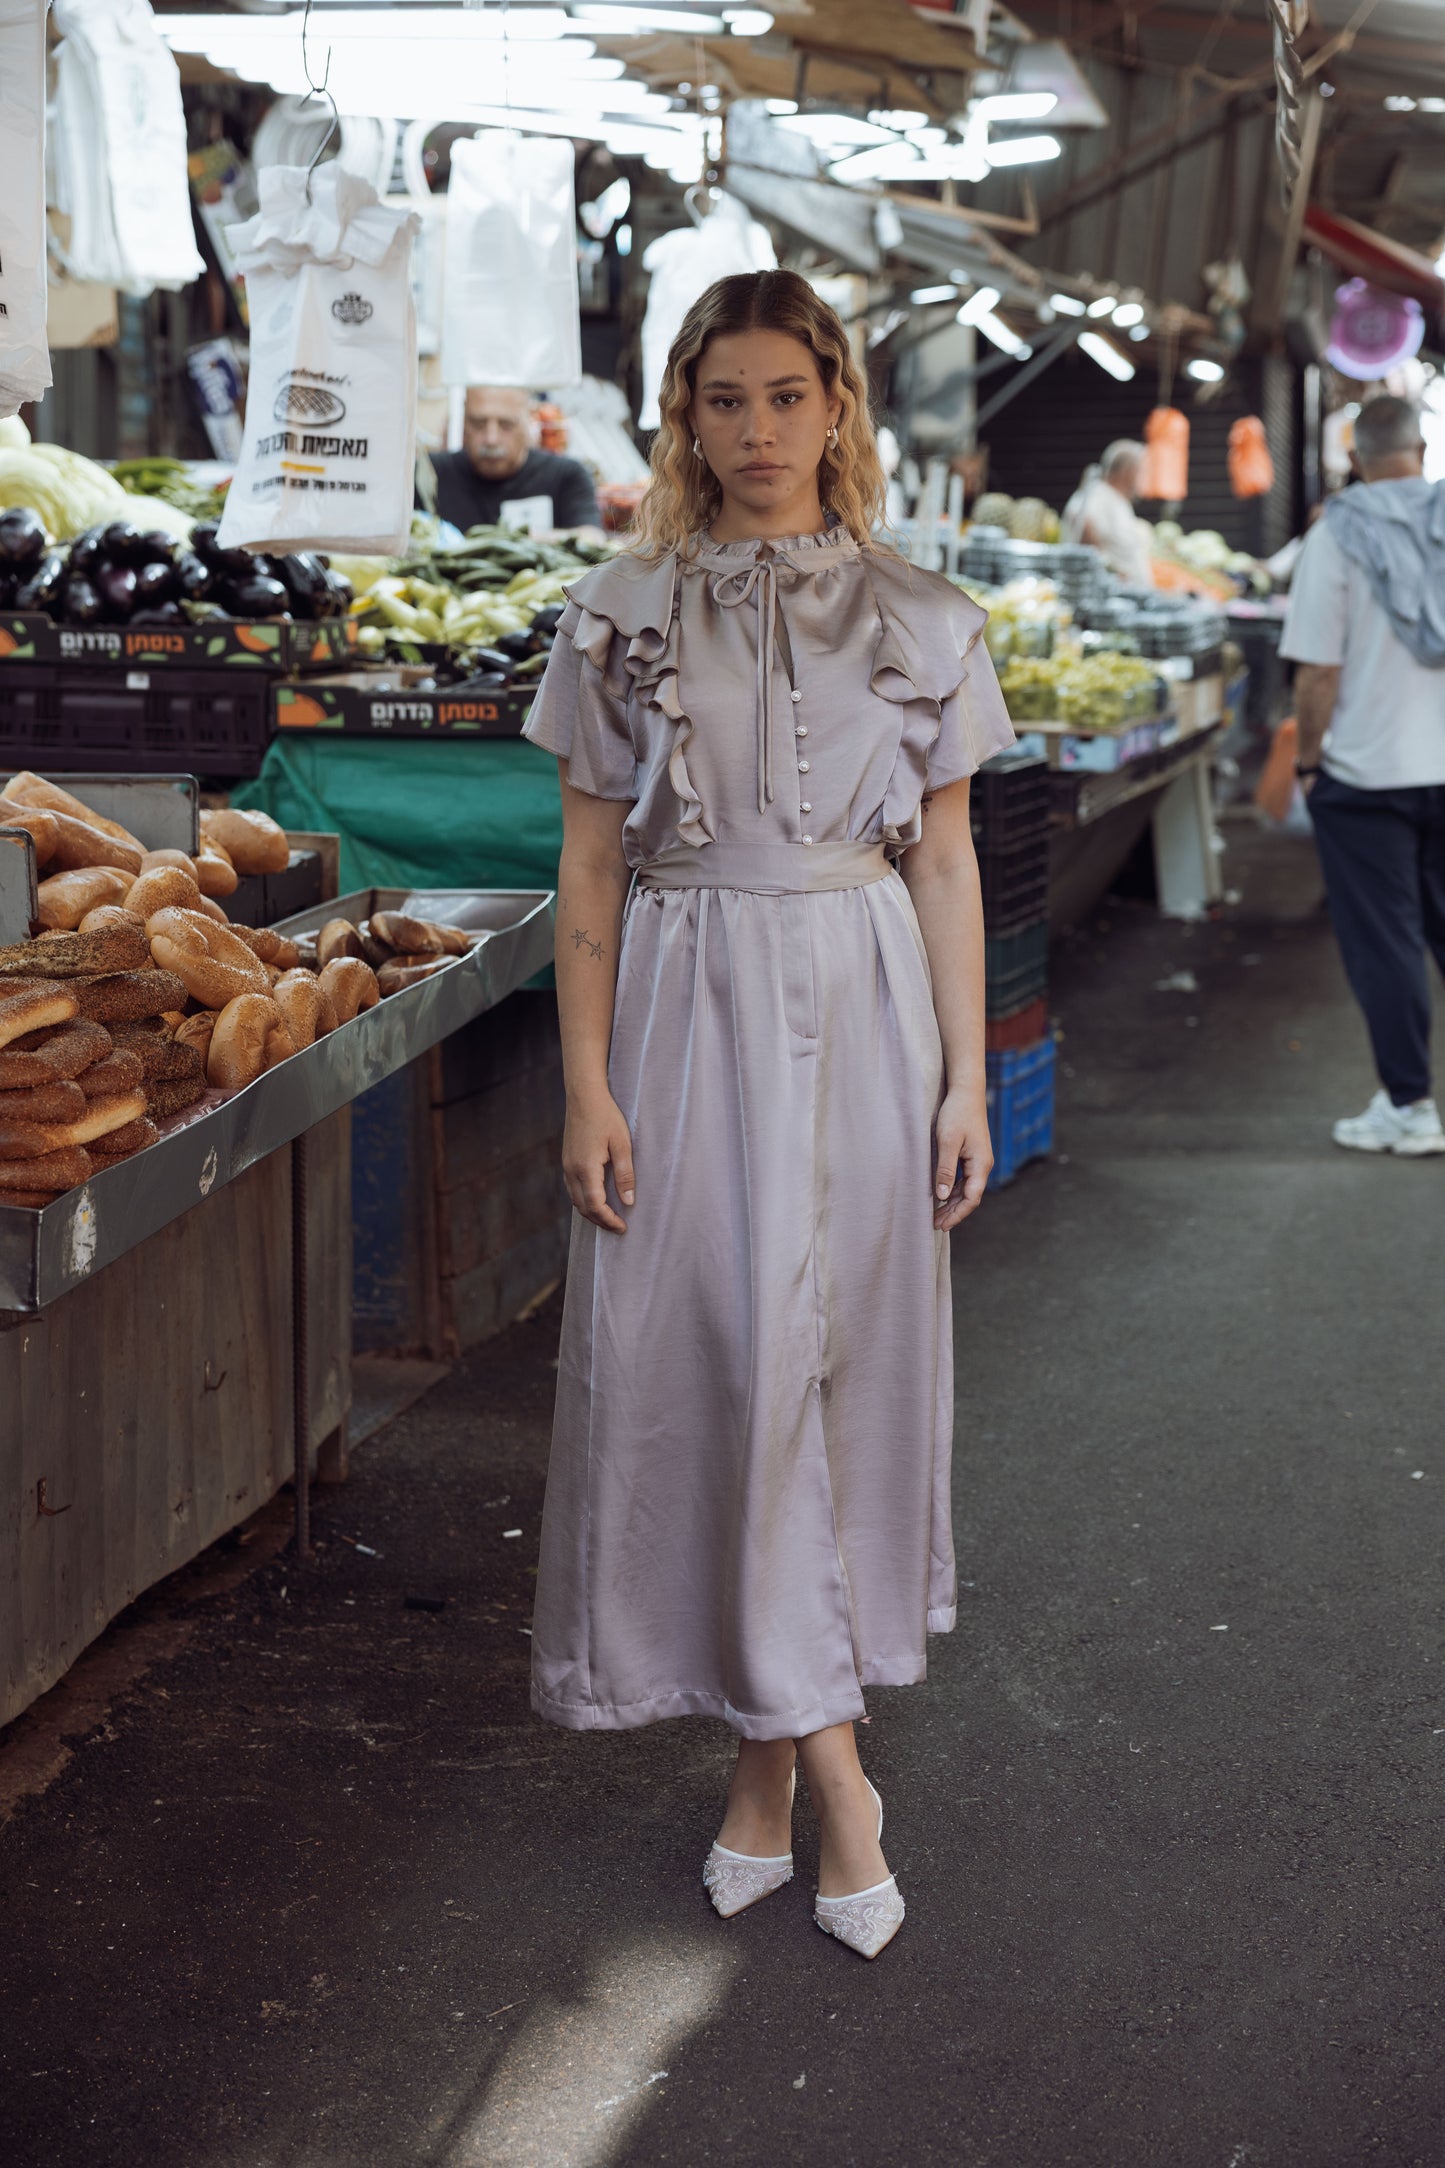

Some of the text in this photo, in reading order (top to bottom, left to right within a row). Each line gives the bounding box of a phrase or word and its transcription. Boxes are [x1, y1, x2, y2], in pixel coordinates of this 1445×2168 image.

[59, 631, 185, 656] בוסתן הדרום
[370, 701, 498, 725] בוסתן הדרום
